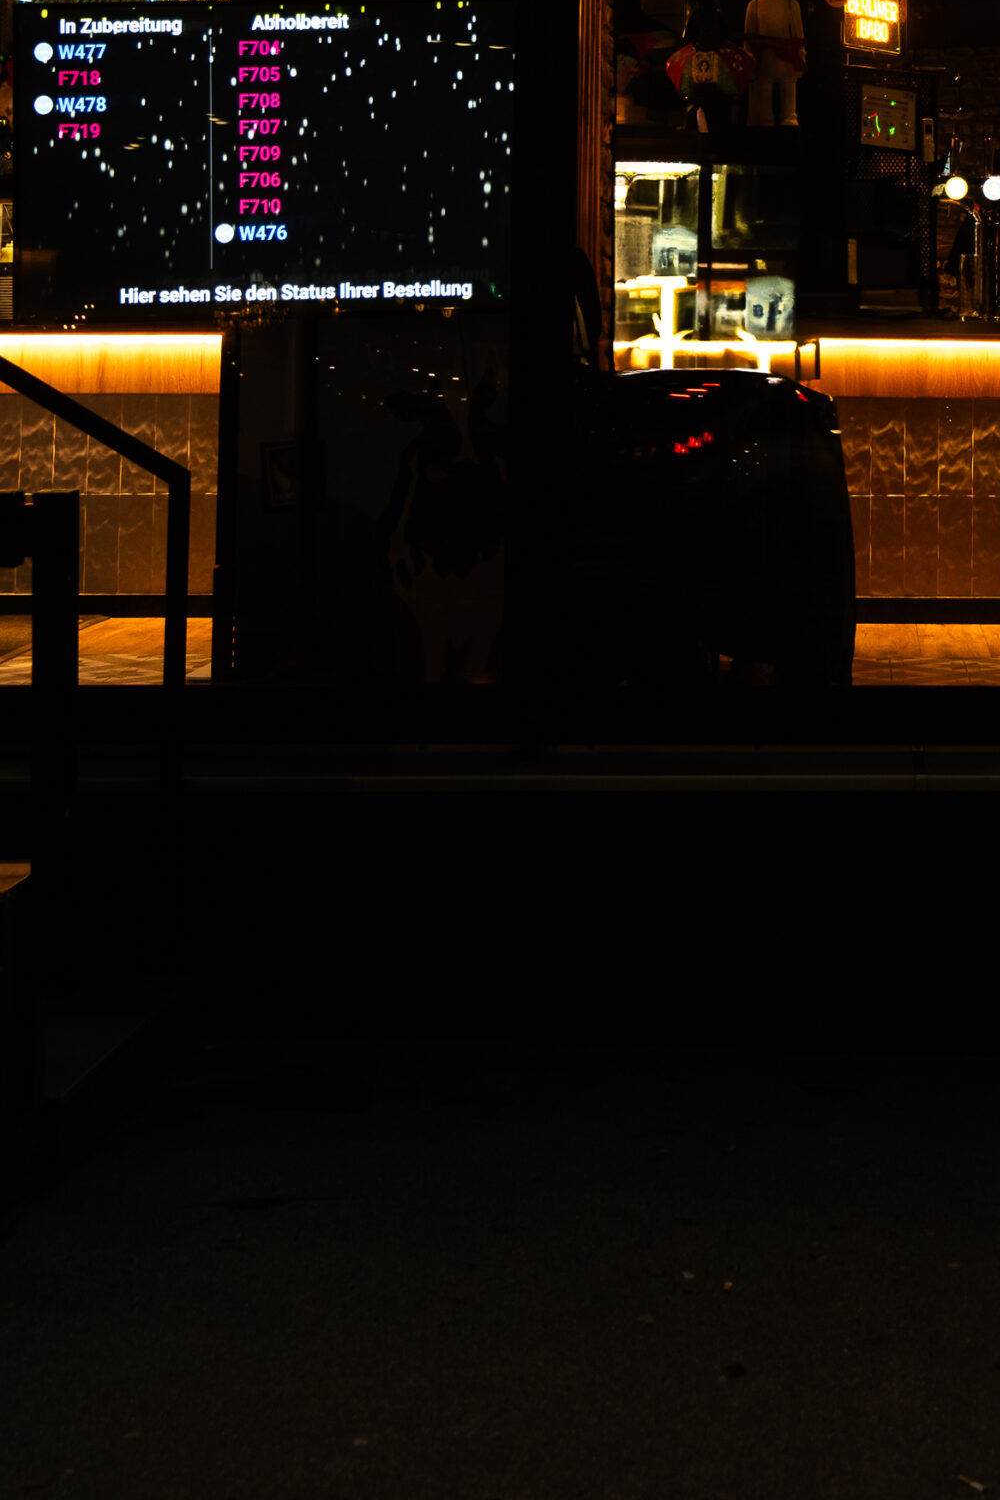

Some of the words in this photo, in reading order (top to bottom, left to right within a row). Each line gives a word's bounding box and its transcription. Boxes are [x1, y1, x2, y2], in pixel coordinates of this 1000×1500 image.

[59, 18, 76, 34] In
[80, 18, 182, 35] Zubereitung
[251, 13, 349, 31] Abholbereit
[858, 18, 888, 42] BABO
[58, 44, 106, 60] W477
[238, 40, 281, 56] F704
[58, 70, 100, 86] F718
[238, 67, 281, 82] F705
[58, 96, 106, 113] W478
[238, 93, 281, 109] F708
[58, 122, 101, 139] F719
[239, 119, 281, 135] F707
[239, 146, 281, 161] F709
[239, 172, 281, 188] F706
[239, 198, 282, 215] F710
[239, 224, 287, 241] W476
[119, 287, 157, 304] Hier
[159, 286, 210, 303] sehen
[214, 285, 242, 303] Sie
[245, 284, 277, 302] den
[281, 283, 337, 301] Status
[340, 282, 379, 300] Ihrer
[383, 280, 473, 300] Bestellung
